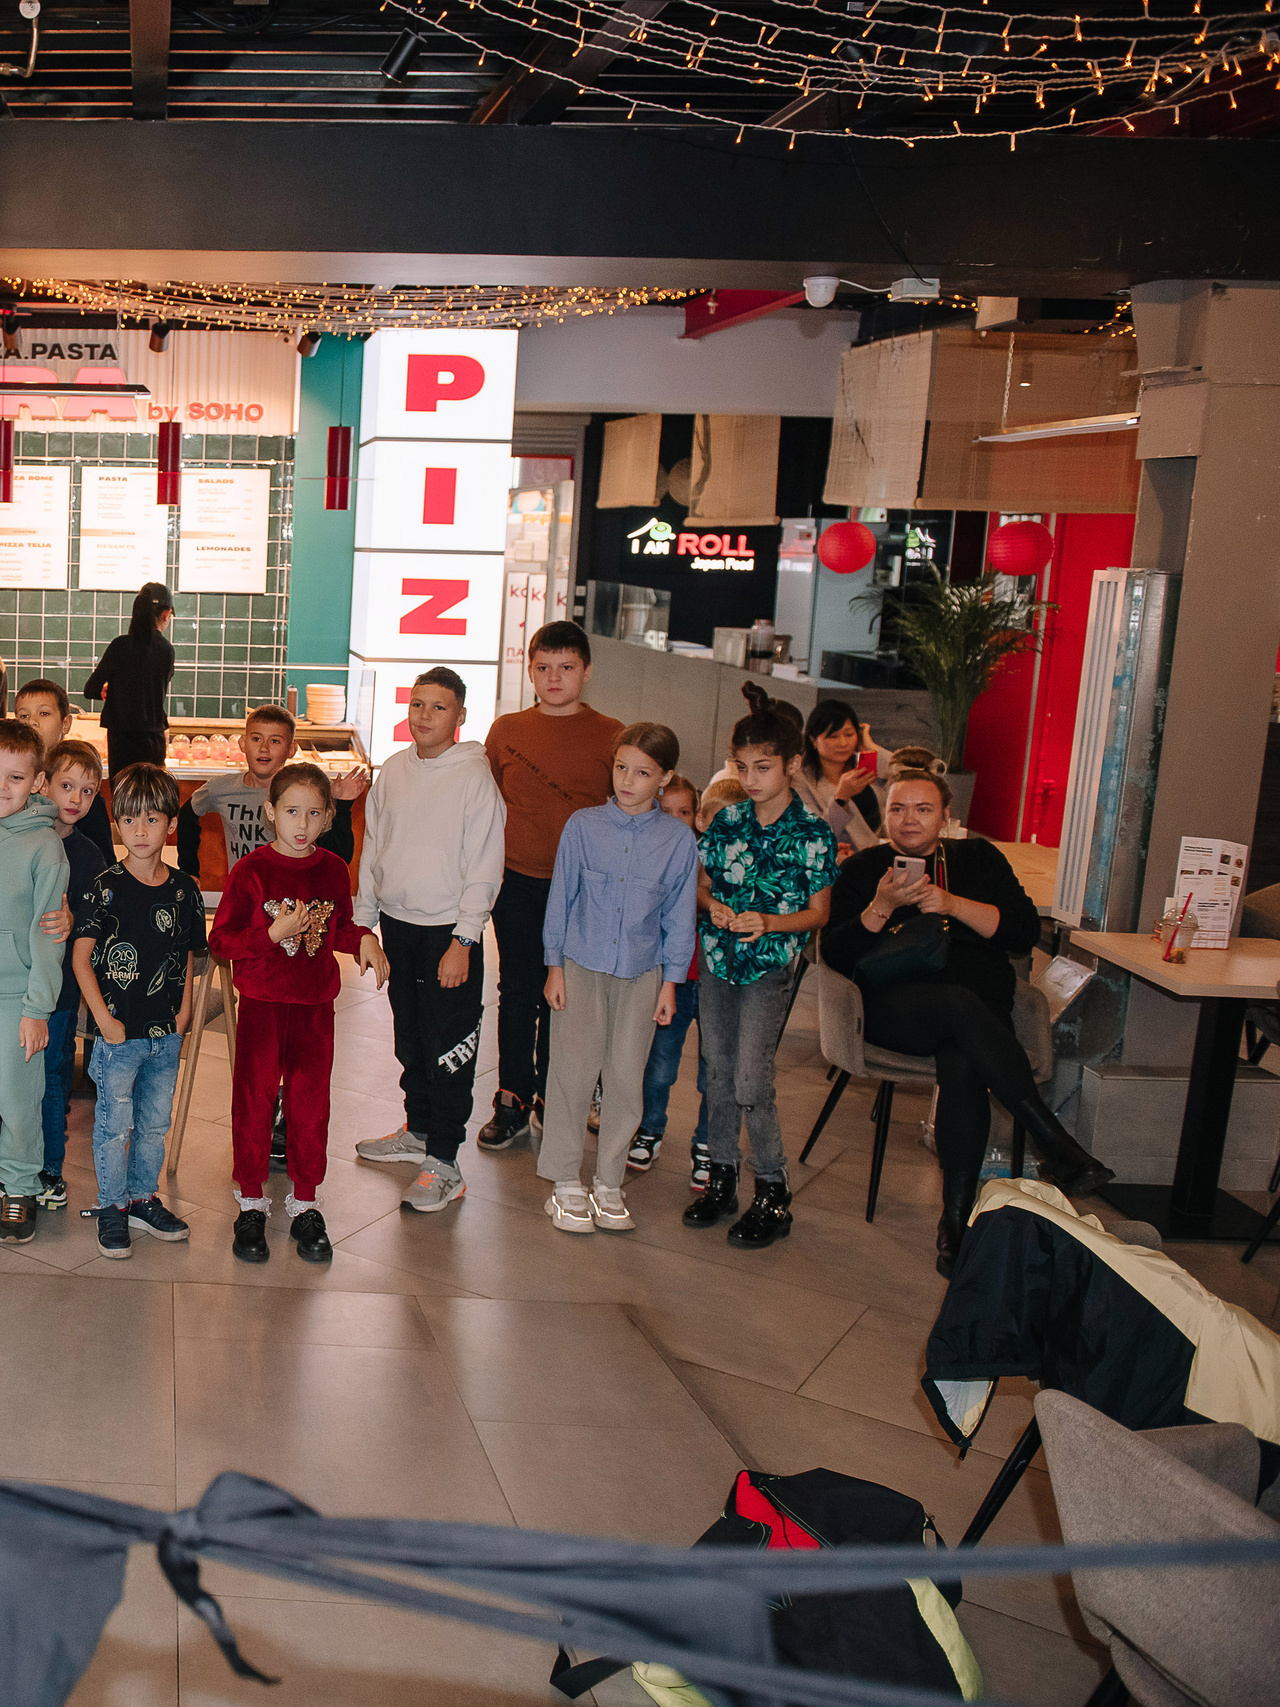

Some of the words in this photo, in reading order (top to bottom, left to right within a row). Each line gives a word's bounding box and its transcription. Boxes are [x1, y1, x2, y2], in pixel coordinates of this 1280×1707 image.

[188, 401, 264, 421] SOHO
[643, 540, 670, 555] AM
[677, 532, 755, 557] ROLL
[690, 557, 725, 572] Japan
[725, 557, 755, 571] Food
[239, 823, 268, 841] NK
[230, 841, 265, 859] HA
[105, 971, 140, 981] TERMIT
